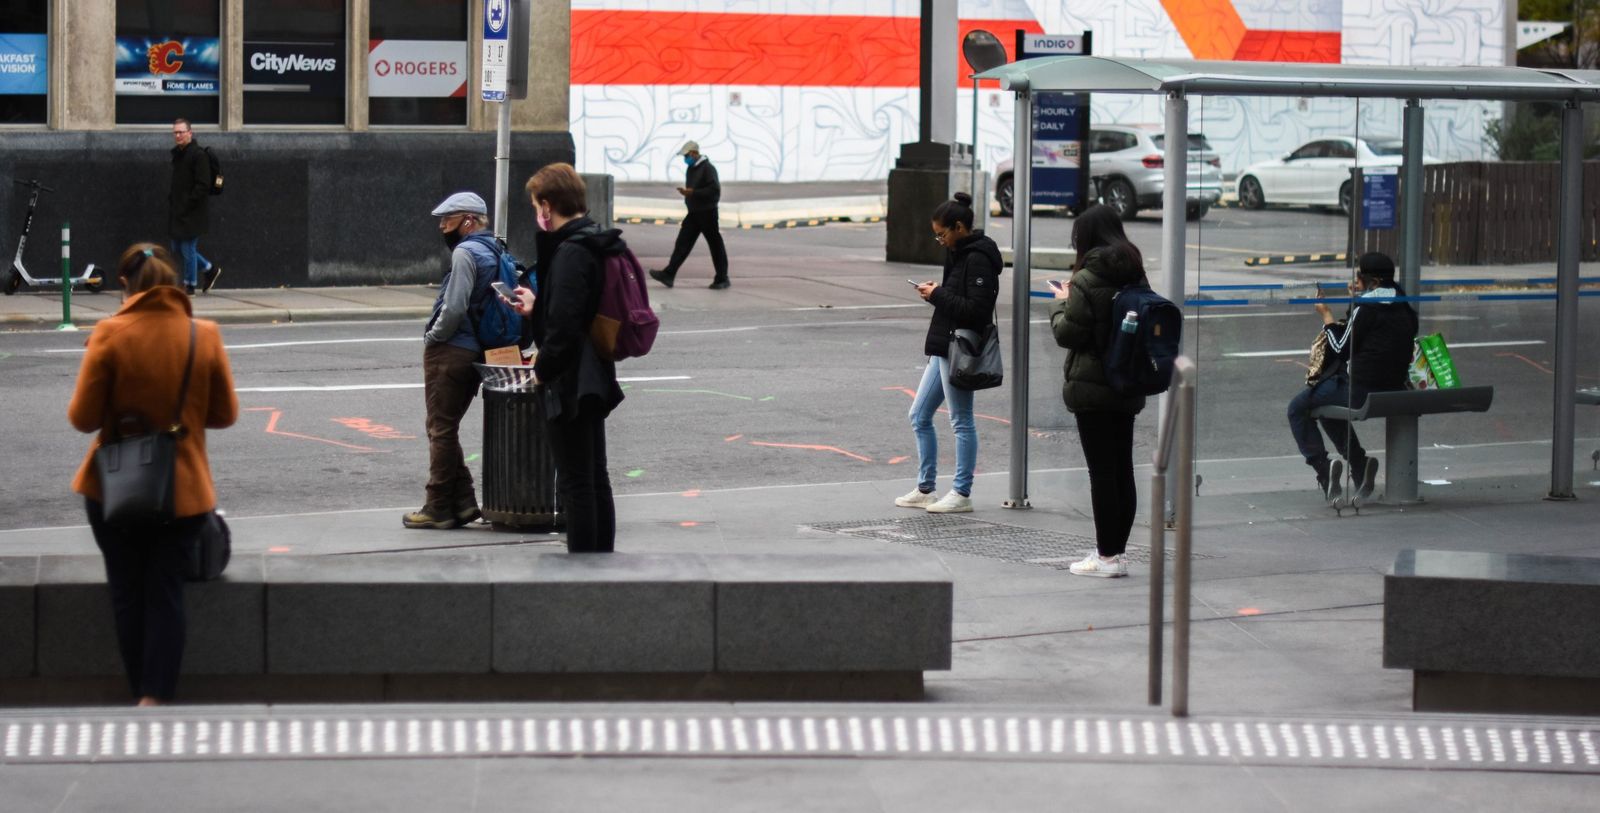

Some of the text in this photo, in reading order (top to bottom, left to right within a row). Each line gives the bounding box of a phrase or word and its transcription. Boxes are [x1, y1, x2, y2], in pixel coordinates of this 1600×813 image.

[1034, 39, 1075, 49] INDIGO
[250, 52, 336, 74] CityNews
[395, 62, 457, 76] ROGERS
[166, 82, 214, 90] HOME FLAMES
[1040, 107, 1076, 117] HOURLY
[1040, 121, 1065, 131] DAILY
